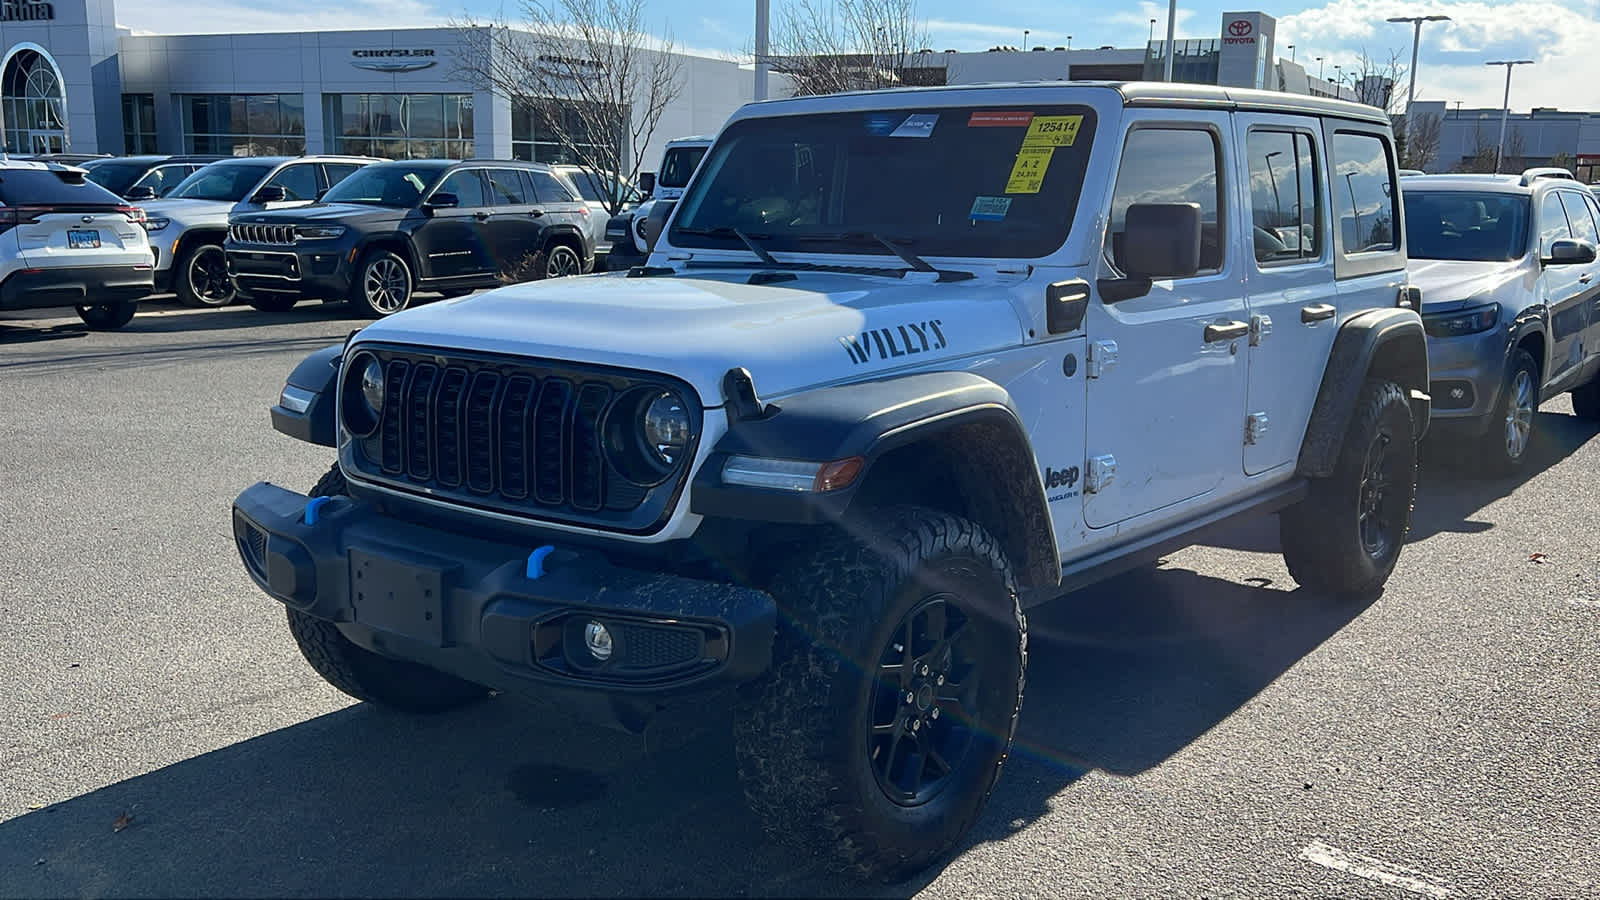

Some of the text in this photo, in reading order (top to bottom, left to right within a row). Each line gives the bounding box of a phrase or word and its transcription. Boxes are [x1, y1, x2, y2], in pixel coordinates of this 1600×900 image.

[1224, 37, 1256, 45] TOYOTA
[352, 49, 435, 58] CHRYSLER
[1038, 121, 1076, 133] 125414
[838, 319, 947, 365] WILLYS
[1045, 466, 1080, 490] Jeep
